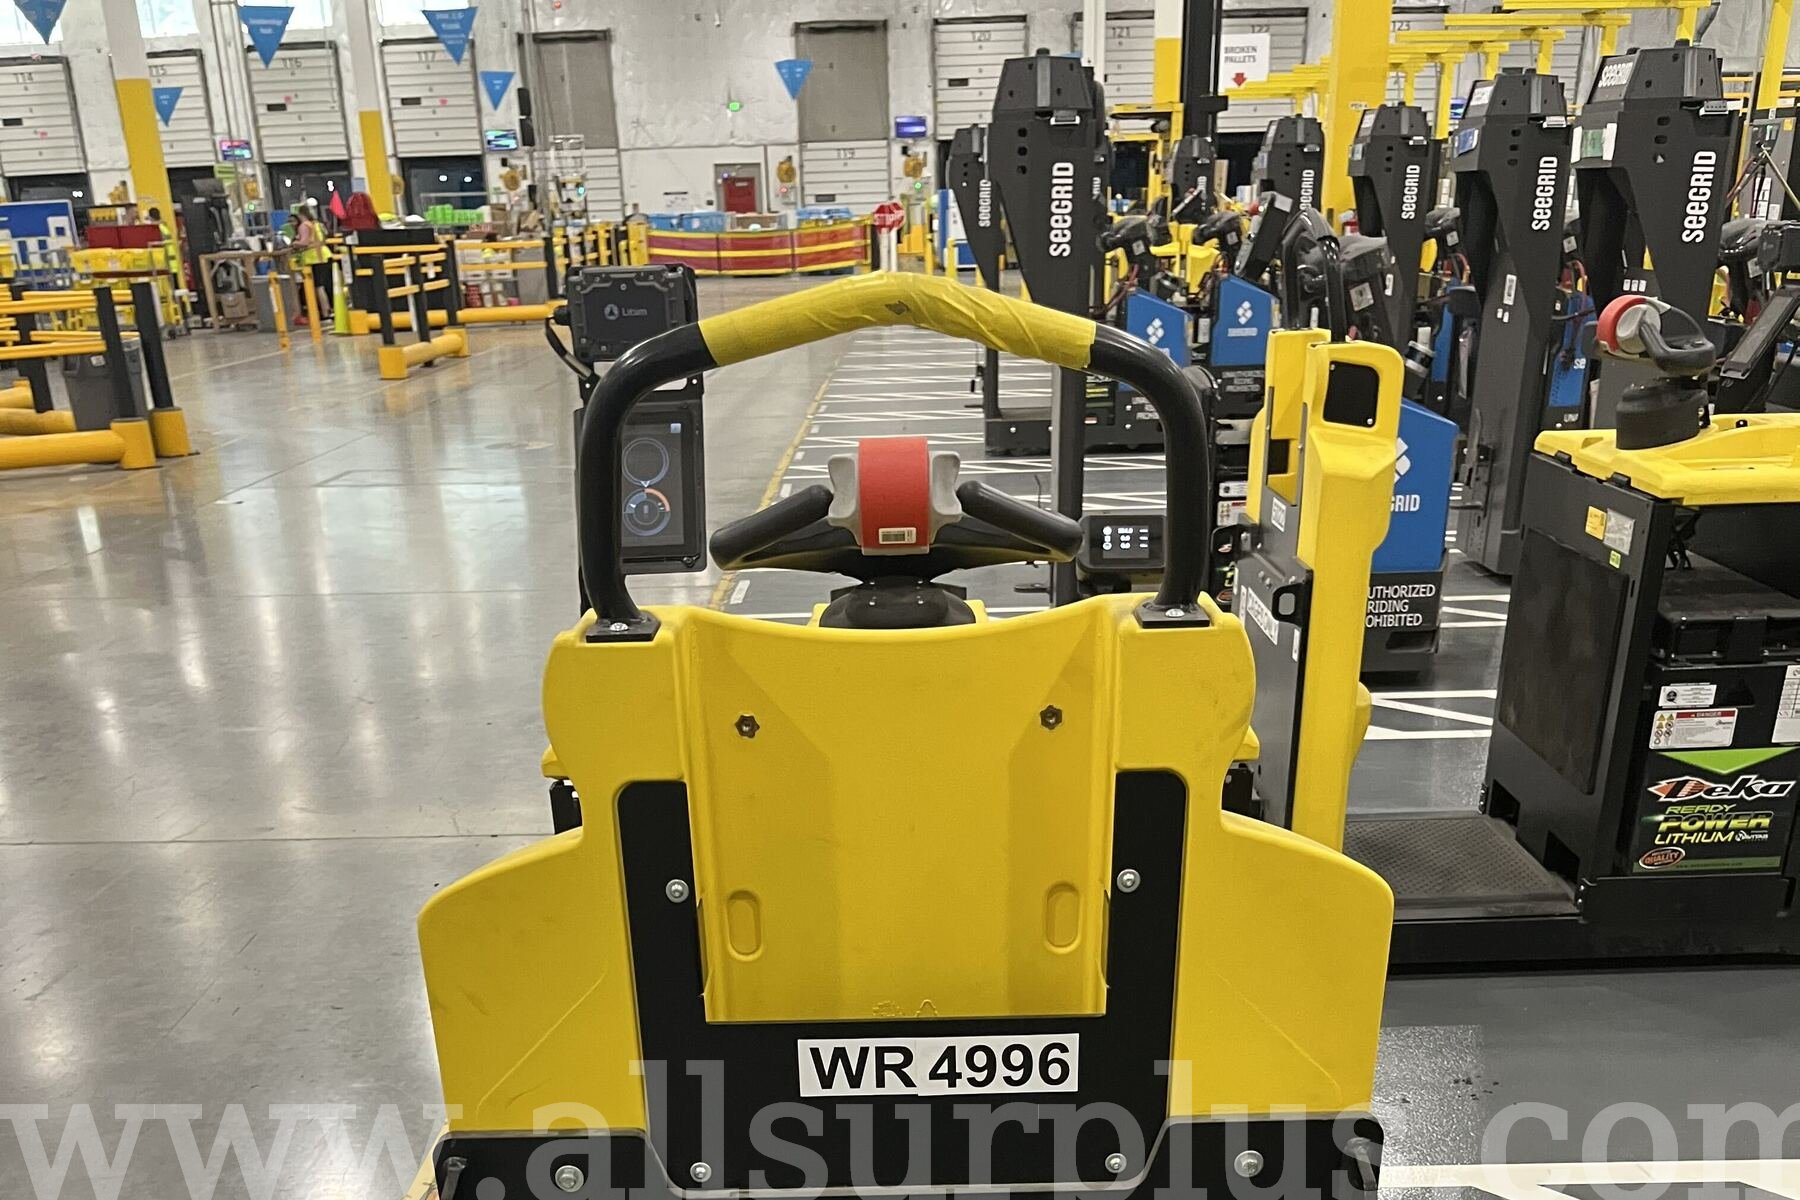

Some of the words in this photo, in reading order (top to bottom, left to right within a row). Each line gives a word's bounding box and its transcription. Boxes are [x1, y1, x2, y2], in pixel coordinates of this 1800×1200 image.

[1224, 46, 1257, 55] BROKEN
[1224, 55, 1256, 63] PALLETS
[1367, 600, 1409, 614] RIDING
[1365, 613, 1423, 628] OHIBITED
[1648, 774, 1796, 802] Deka
[1665, 804, 1737, 814] READY
[1658, 811, 1774, 833] POWER
[1655, 831, 1735, 845] LITHIUM
[1644, 851, 1680, 865] QUALITY
[809, 1046, 917, 1090] WR
[928, 1042, 1070, 1089] 4996
